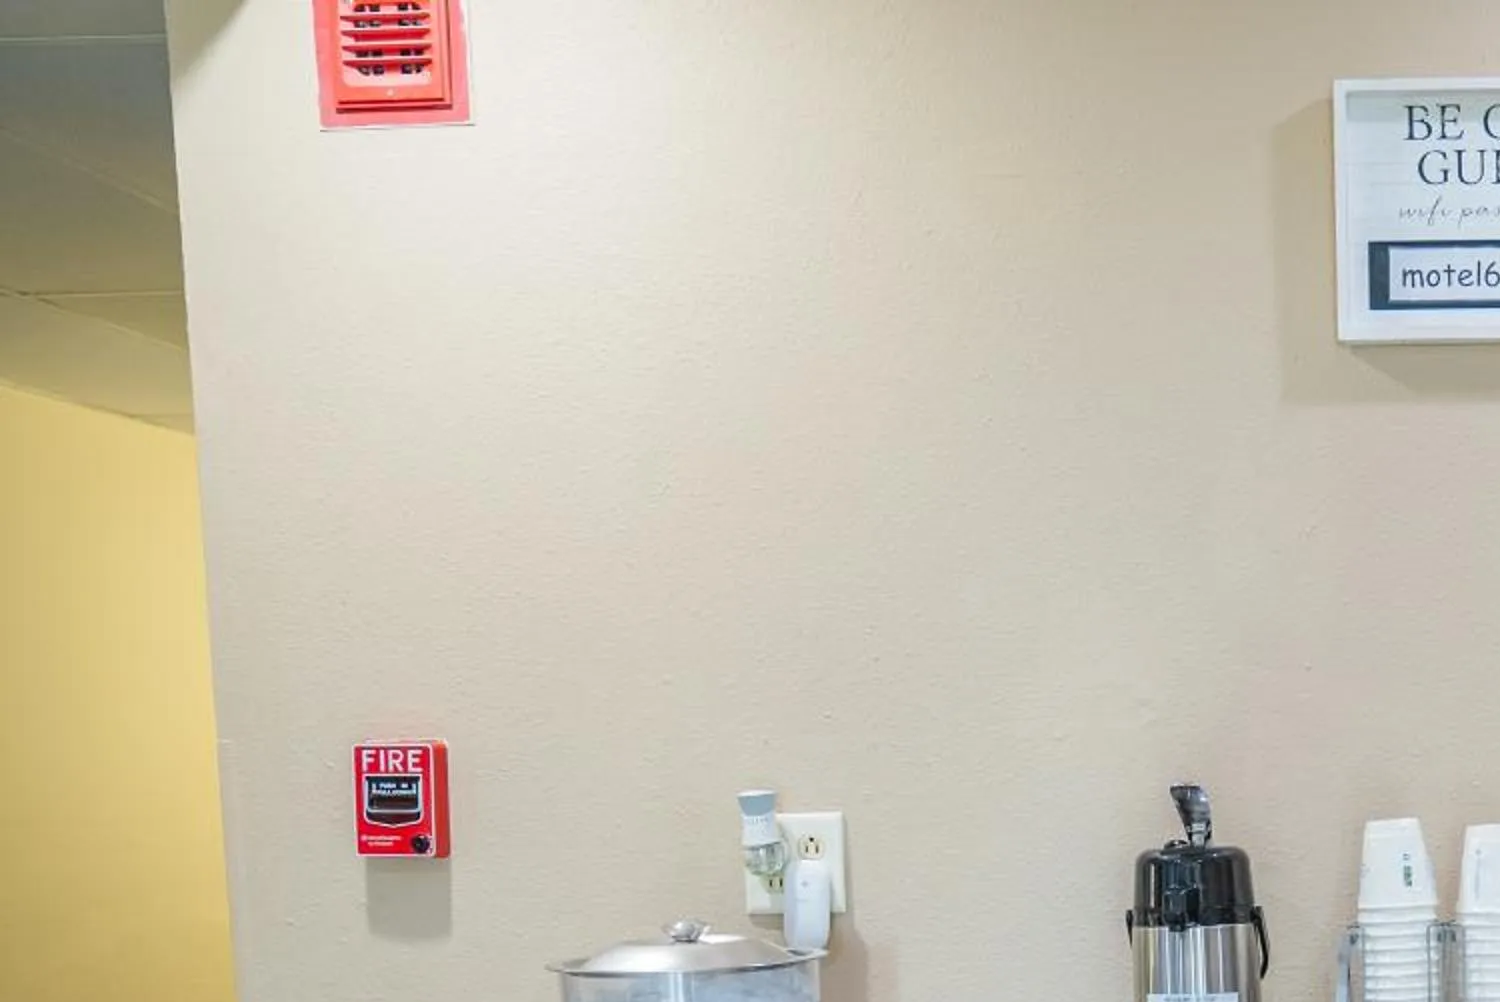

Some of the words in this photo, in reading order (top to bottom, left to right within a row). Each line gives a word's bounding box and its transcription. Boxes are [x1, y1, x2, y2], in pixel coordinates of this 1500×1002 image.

[1403, 104, 1465, 141] BE
[1398, 195, 1453, 226] wifi
[362, 749, 423, 772] FIRE
